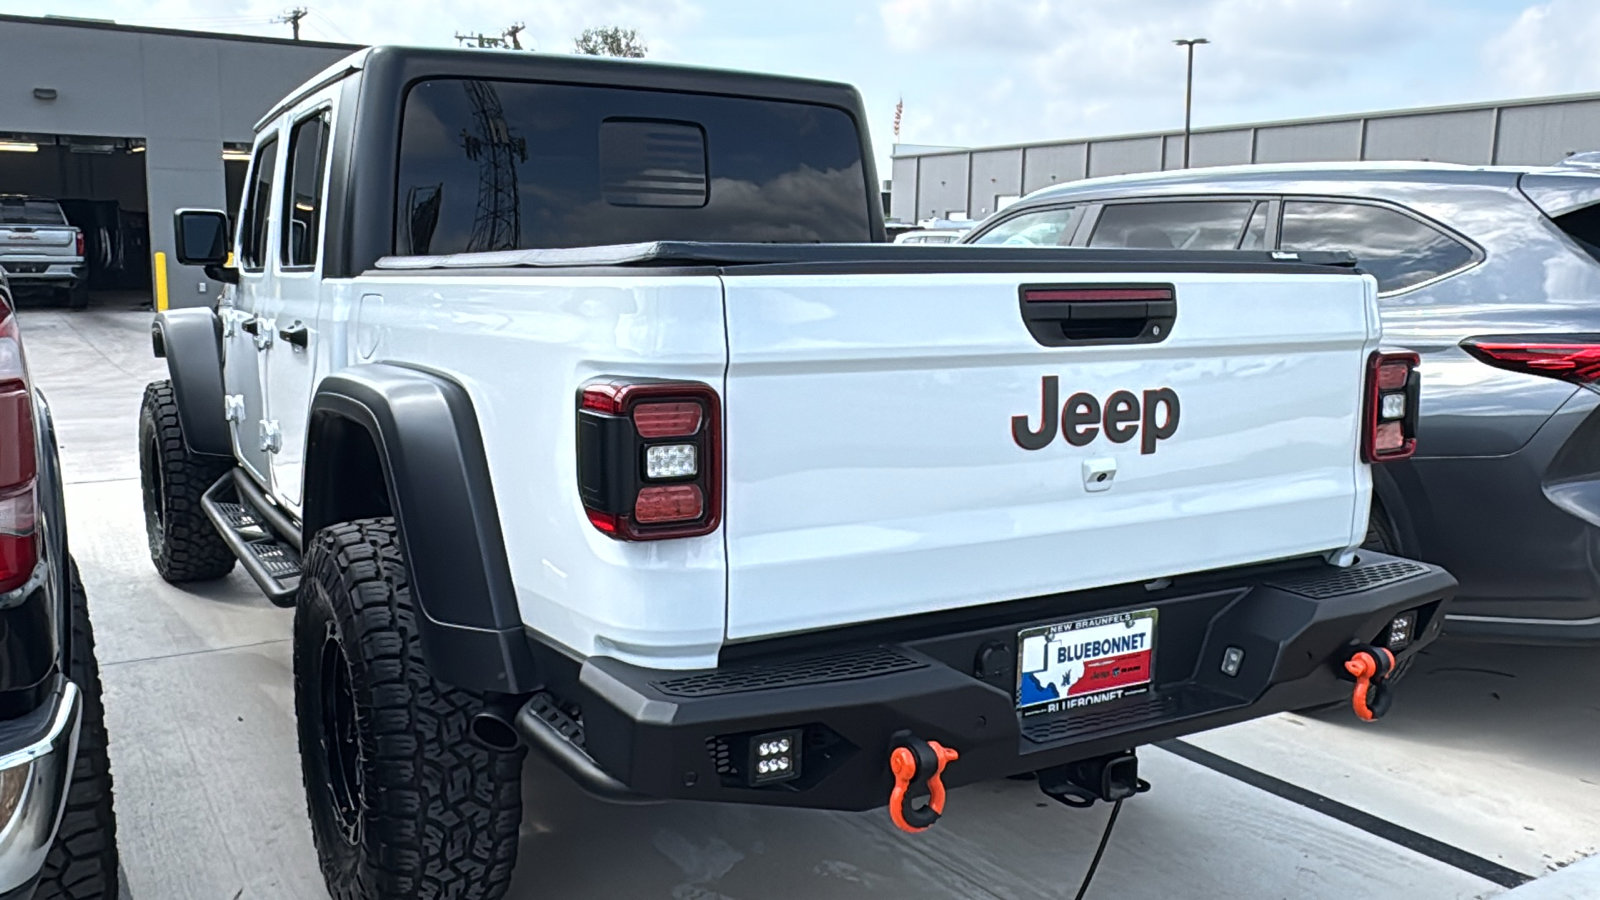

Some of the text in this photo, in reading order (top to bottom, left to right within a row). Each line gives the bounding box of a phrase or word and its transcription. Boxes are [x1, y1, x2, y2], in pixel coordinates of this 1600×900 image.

[1011, 375, 1181, 455] Jeep
[1050, 613, 1131, 633] NEW BRAUNFELS
[1057, 632, 1146, 664] BLUEBONNET
